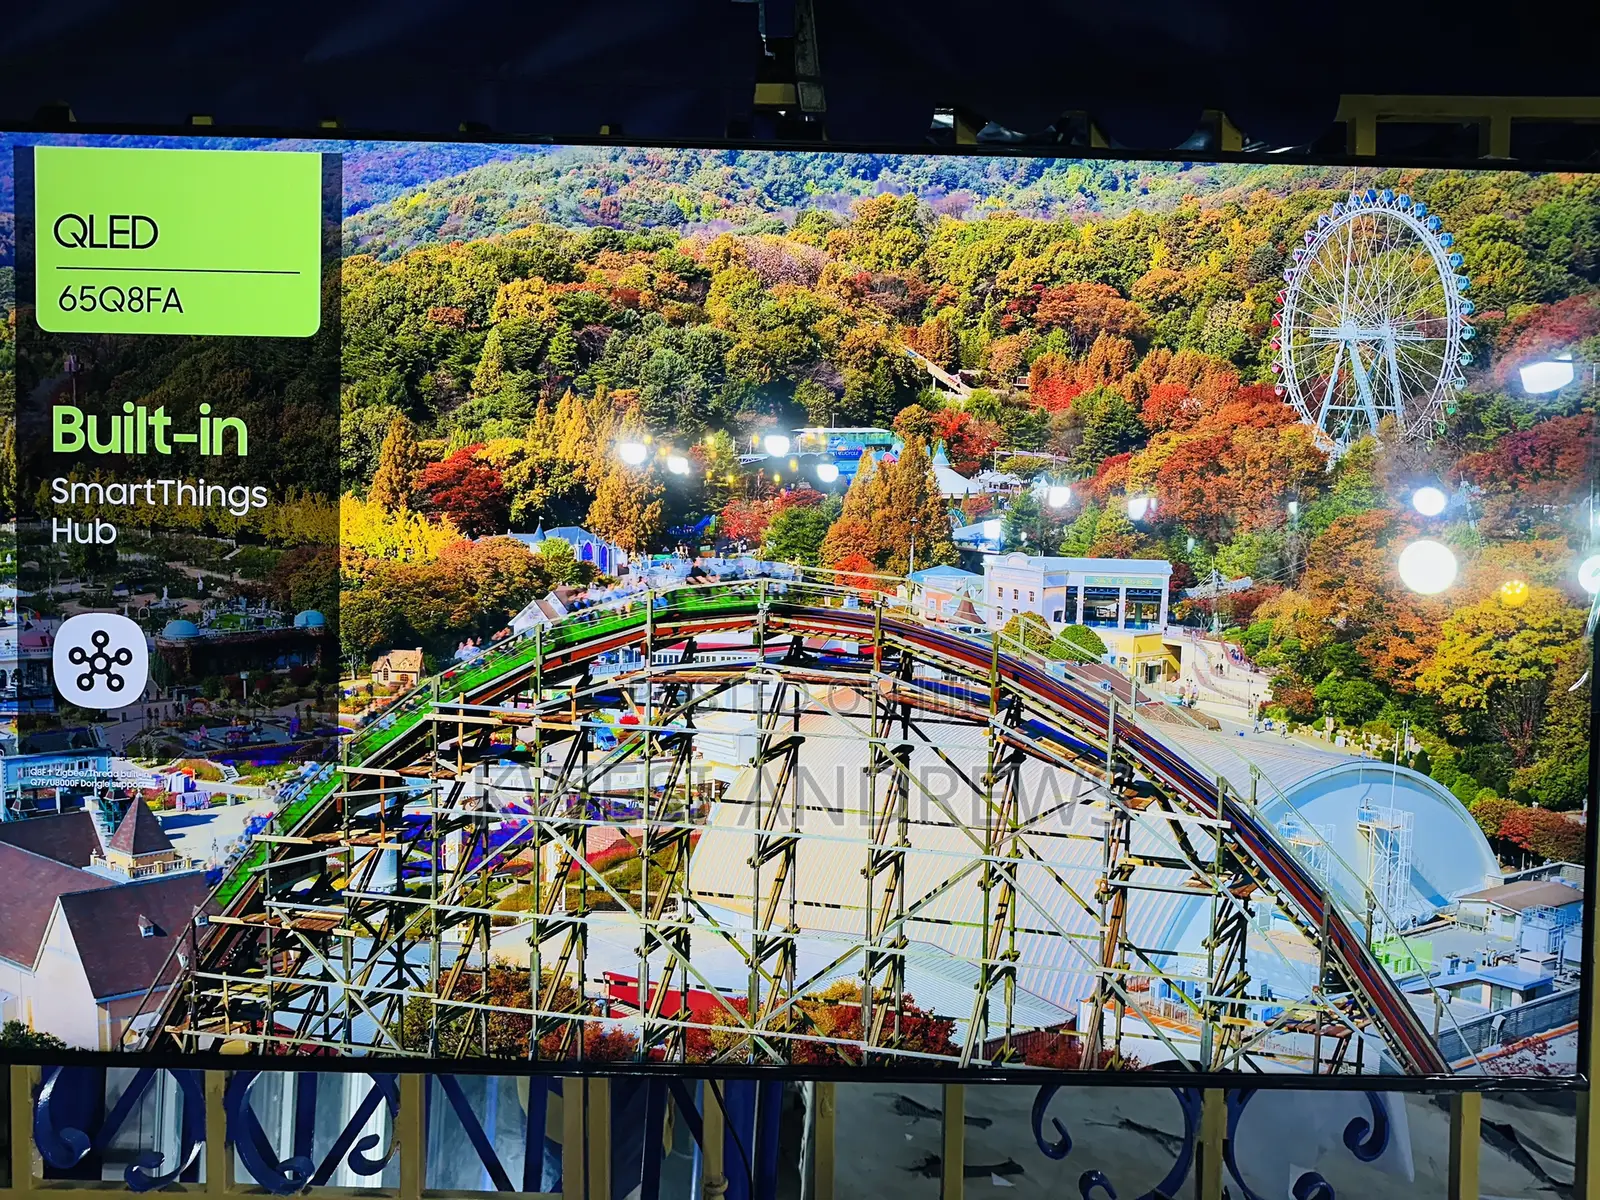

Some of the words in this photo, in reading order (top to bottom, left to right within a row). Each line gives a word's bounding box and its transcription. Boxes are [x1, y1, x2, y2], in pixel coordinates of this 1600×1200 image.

[53, 213, 159, 249] QLED
[58, 285, 184, 313] 65Q8FA
[52, 402, 248, 457] Built-in
[51, 477, 268, 515] SmartThings
[52, 518, 117, 544] Hub
[80, 779, 109, 789] Dongle
